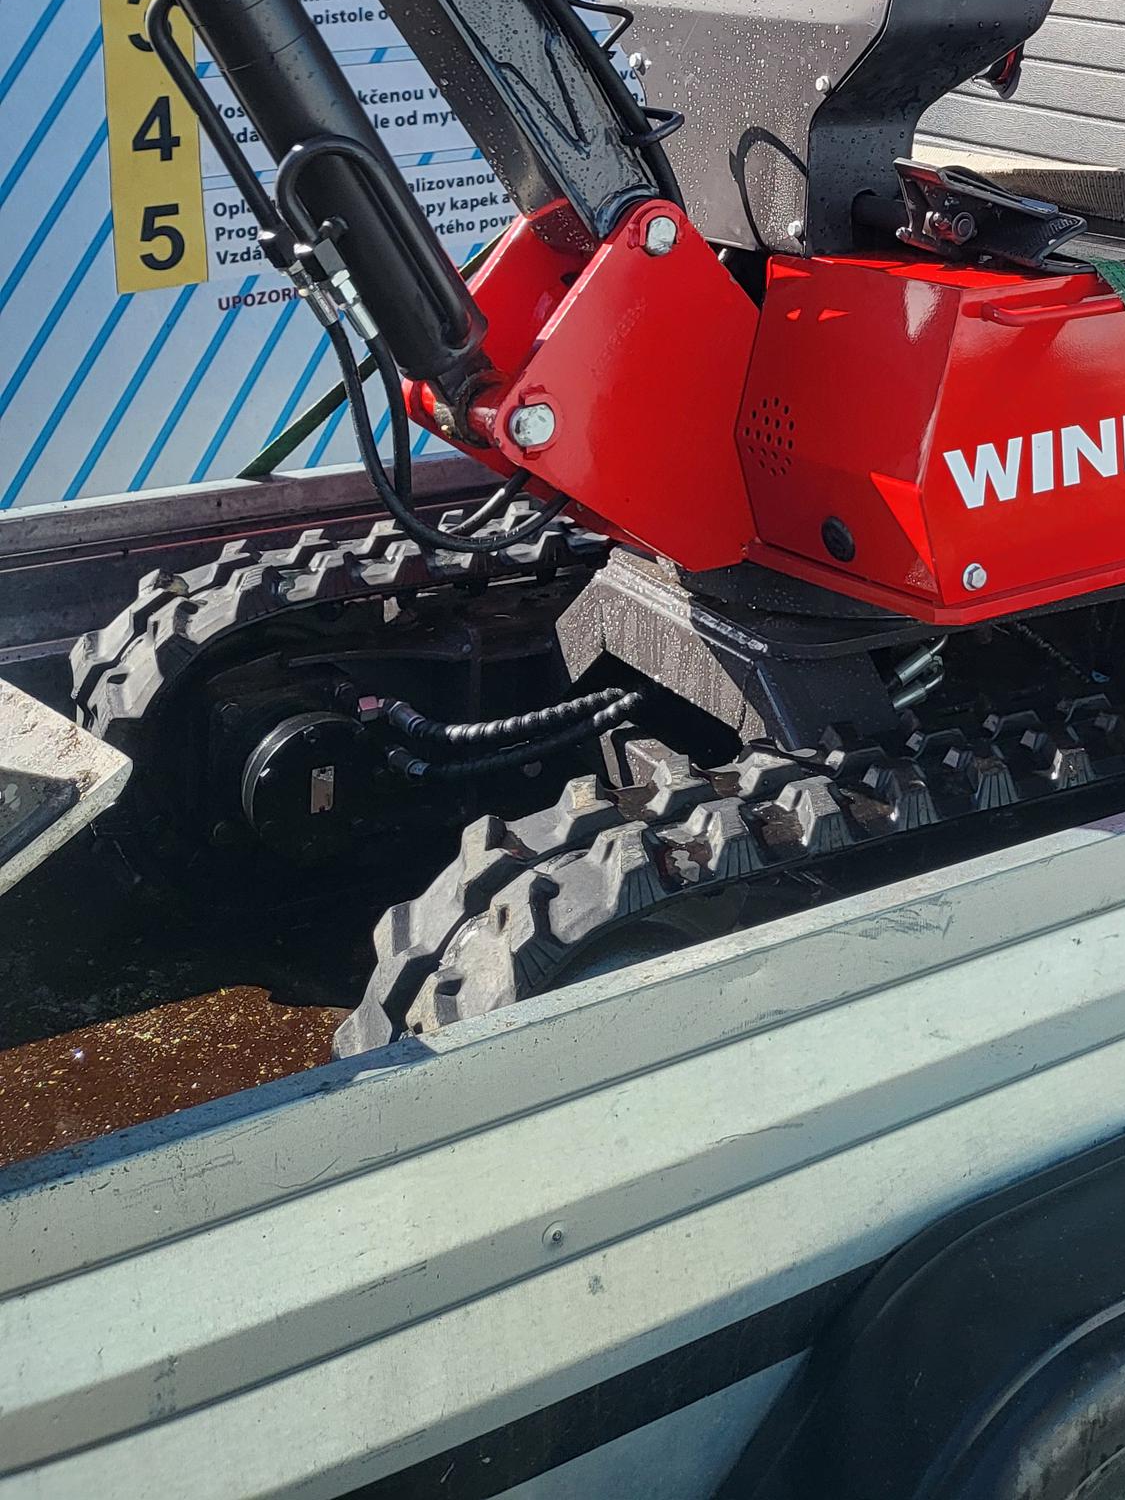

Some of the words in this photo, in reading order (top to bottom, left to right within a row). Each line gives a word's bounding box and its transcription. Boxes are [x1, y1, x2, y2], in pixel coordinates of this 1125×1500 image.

[358, 89, 424, 105] kčenou
[395, 110, 417, 127] od
[132, 96, 180, 162] 4
[140, 203, 185, 271] 5
[215, 225, 258, 242] Prog
[450, 191, 499, 212] kapek
